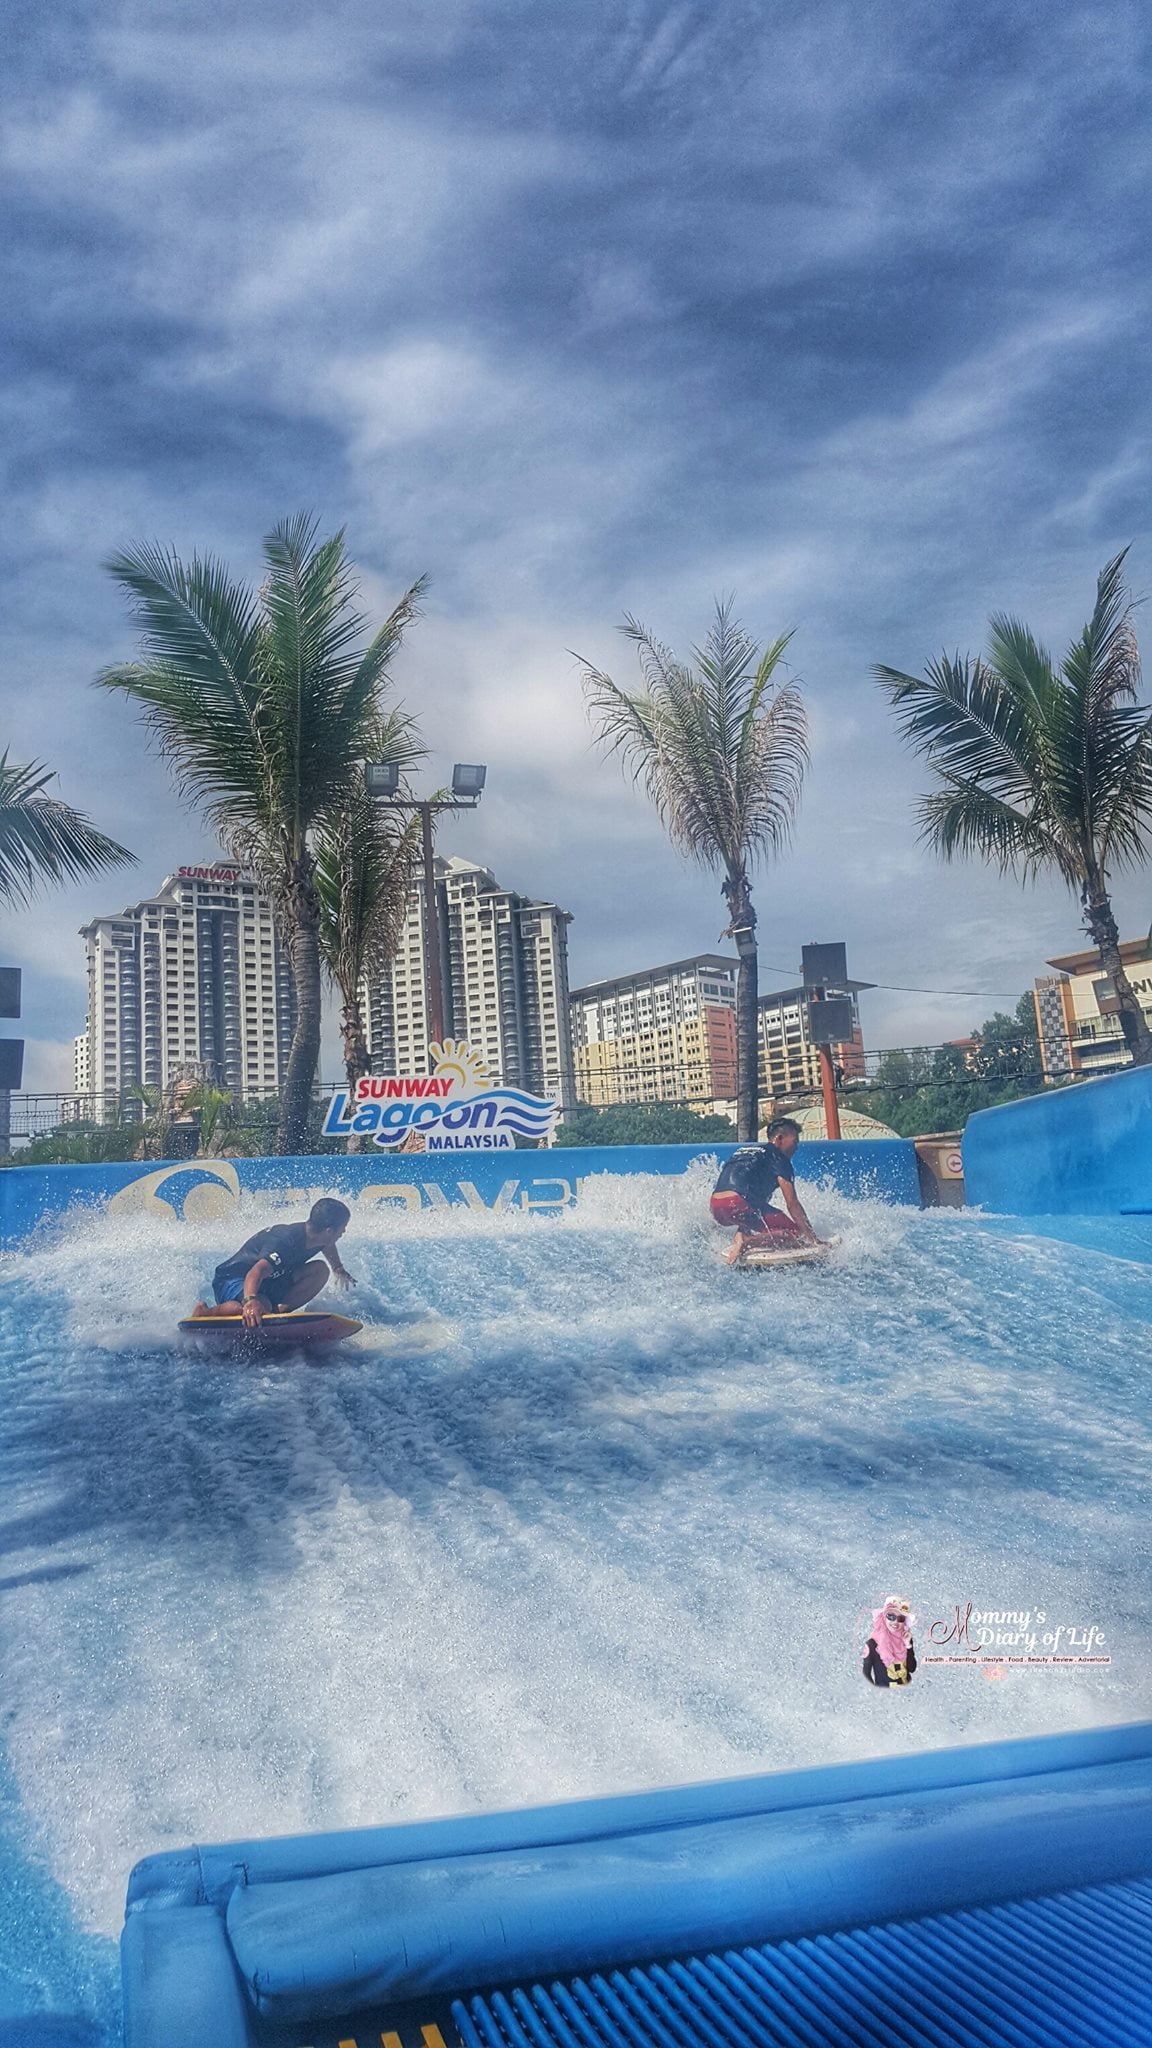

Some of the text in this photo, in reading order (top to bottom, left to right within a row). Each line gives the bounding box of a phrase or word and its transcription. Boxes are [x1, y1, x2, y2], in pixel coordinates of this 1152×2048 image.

[178, 866, 241, 881] SUNWAY
[357, 1078, 454, 1098] SUNWAY
[325, 1094, 498, 1143] Lagoon
[428, 1134, 509, 1149] MALAYSIA
